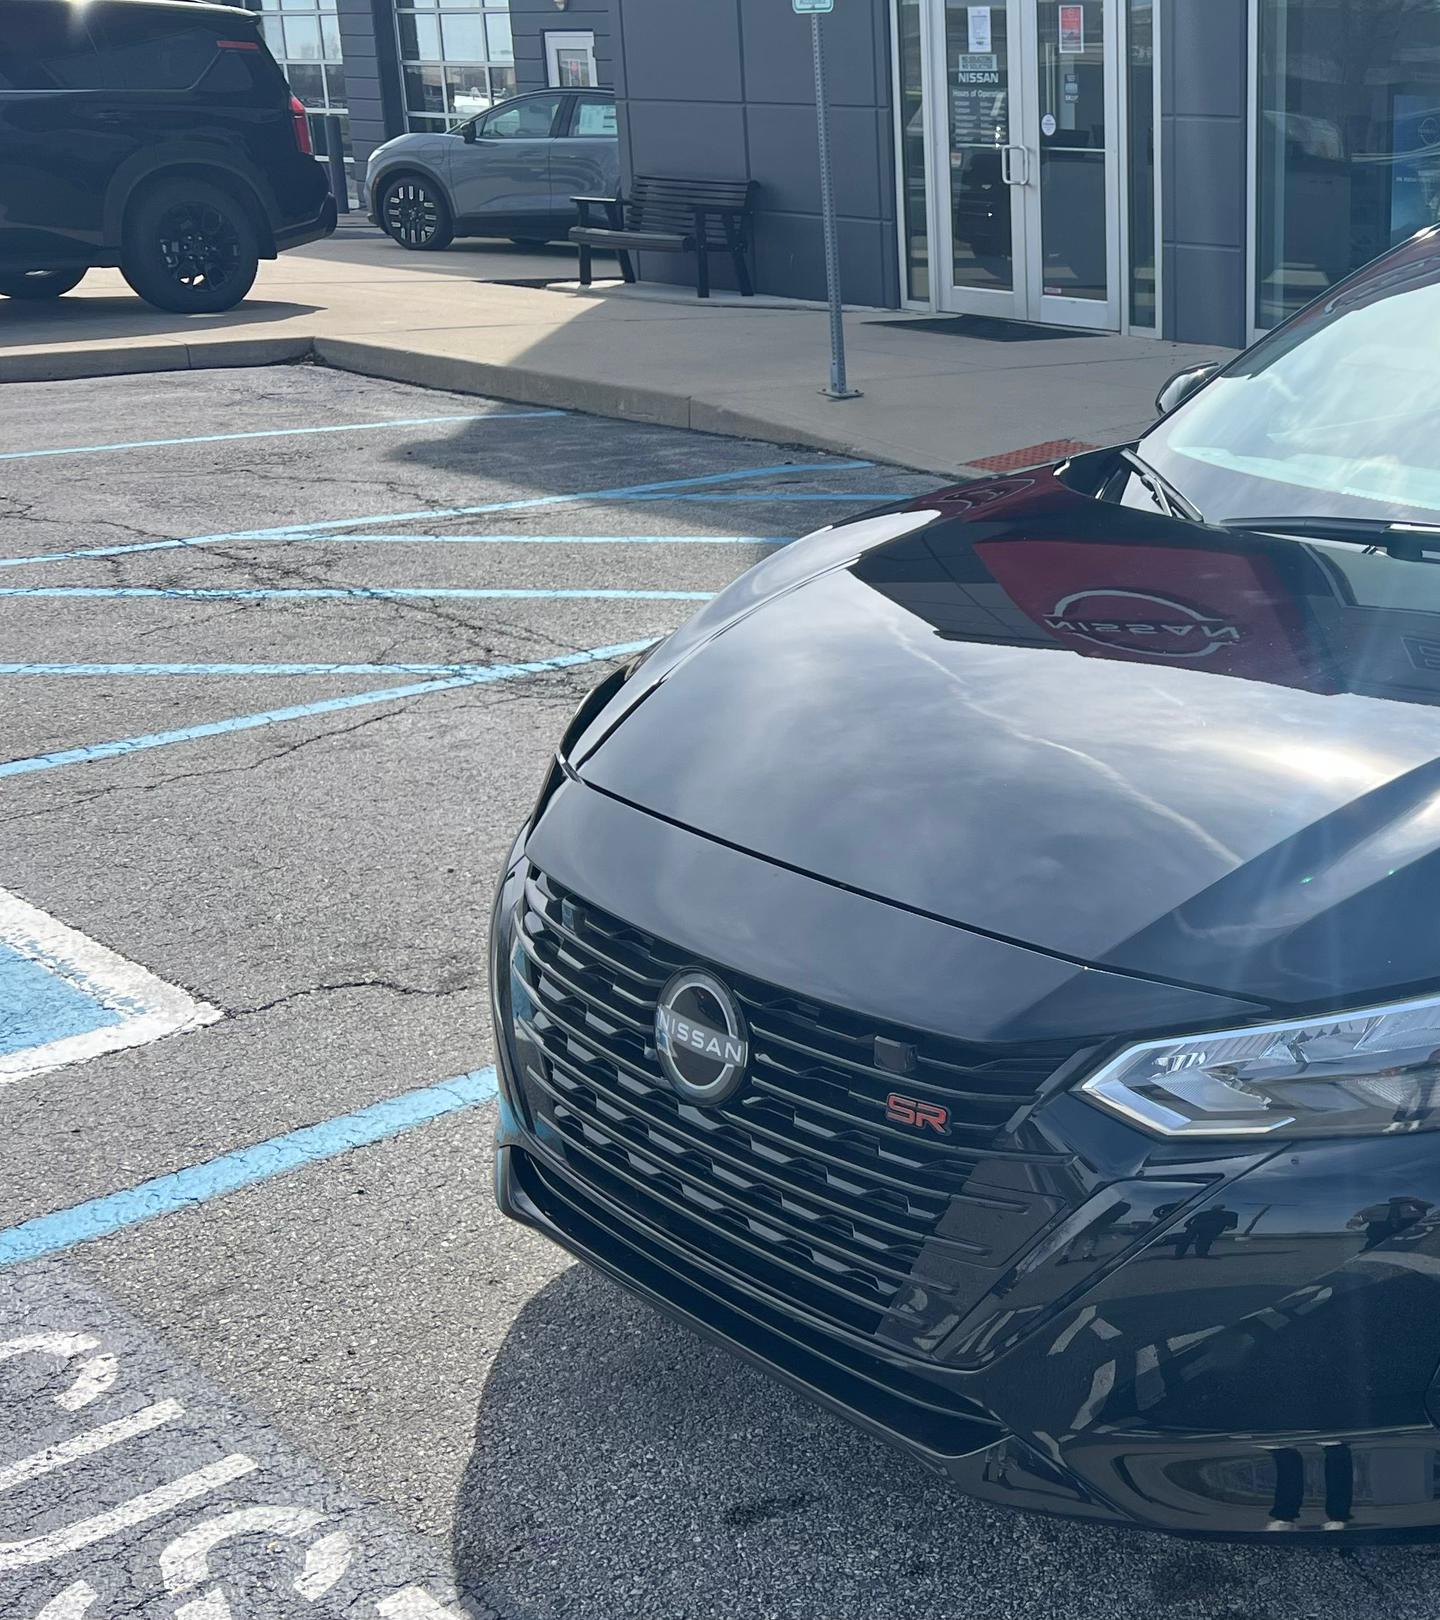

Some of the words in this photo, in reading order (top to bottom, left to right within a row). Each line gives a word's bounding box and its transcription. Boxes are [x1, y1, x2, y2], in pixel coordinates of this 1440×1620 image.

[958, 72, 999, 83] NISSAN
[656, 1005, 743, 1063] NISSAN
[886, 1093, 949, 1134] SR
